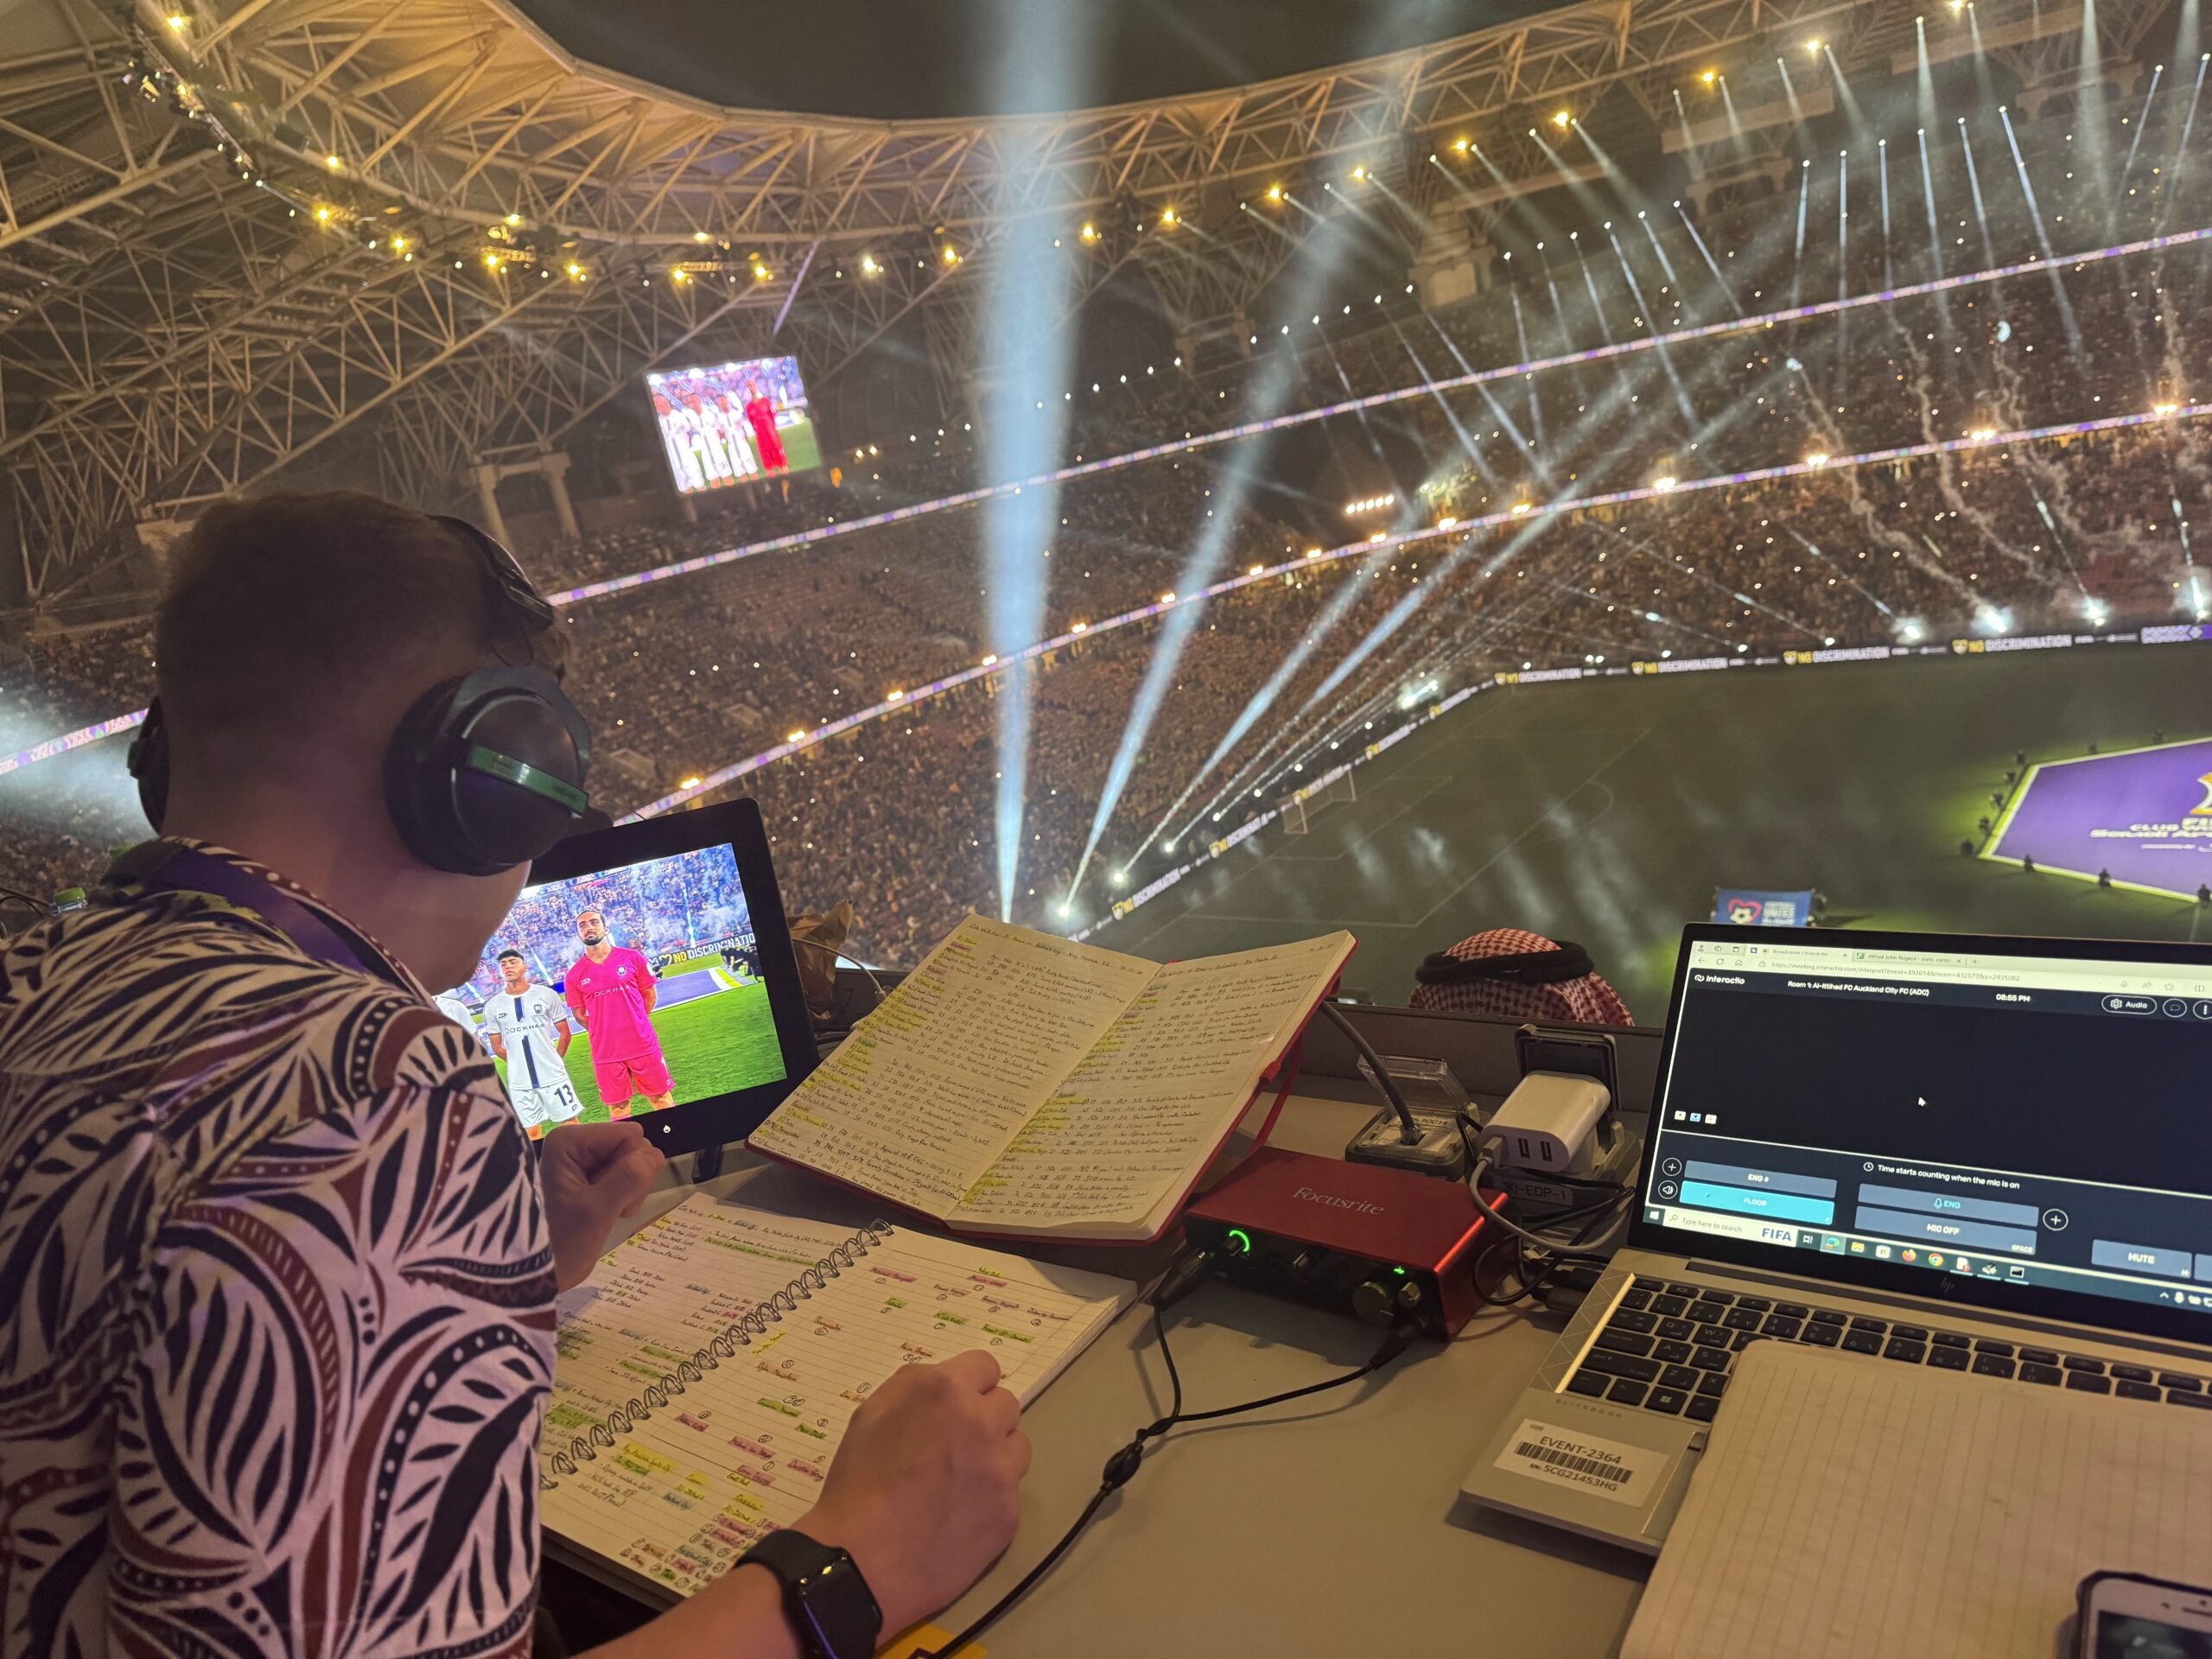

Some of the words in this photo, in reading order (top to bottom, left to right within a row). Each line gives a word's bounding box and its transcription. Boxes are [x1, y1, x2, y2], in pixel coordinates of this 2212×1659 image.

[674, 951, 688, 963] NO
[1706, 975, 1745, 985] Interactio
[1853, 985, 1884, 994] Auckland
[1885, 987, 1898, 995] City
[2125, 1001, 2148, 1009] Audio
[554, 1084, 574, 1107] 13
[1878, 1164, 1895, 1173] Time
[1896, 1166, 1916, 1176] starts
[1917, 1170, 1950, 1181] counting
[1951, 1174, 1972, 1183] when
[1973, 1176, 1986, 1185] the
[1292, 1186, 1384, 1215] Focusrite
[1743, 1197, 1767, 1206] FLOOR
[1943, 1200, 1961, 1209] ENG
[1681, 1217, 1697, 1226] Type
[1721, 1224, 1743, 1233] search
[1943, 1226, 1960, 1236] OFF
[1761, 1228, 1791, 1242] FIFA
[2127, 1252, 2156, 1265] MUTE
[1540, 1436, 1622, 1464] EVENT-2364
